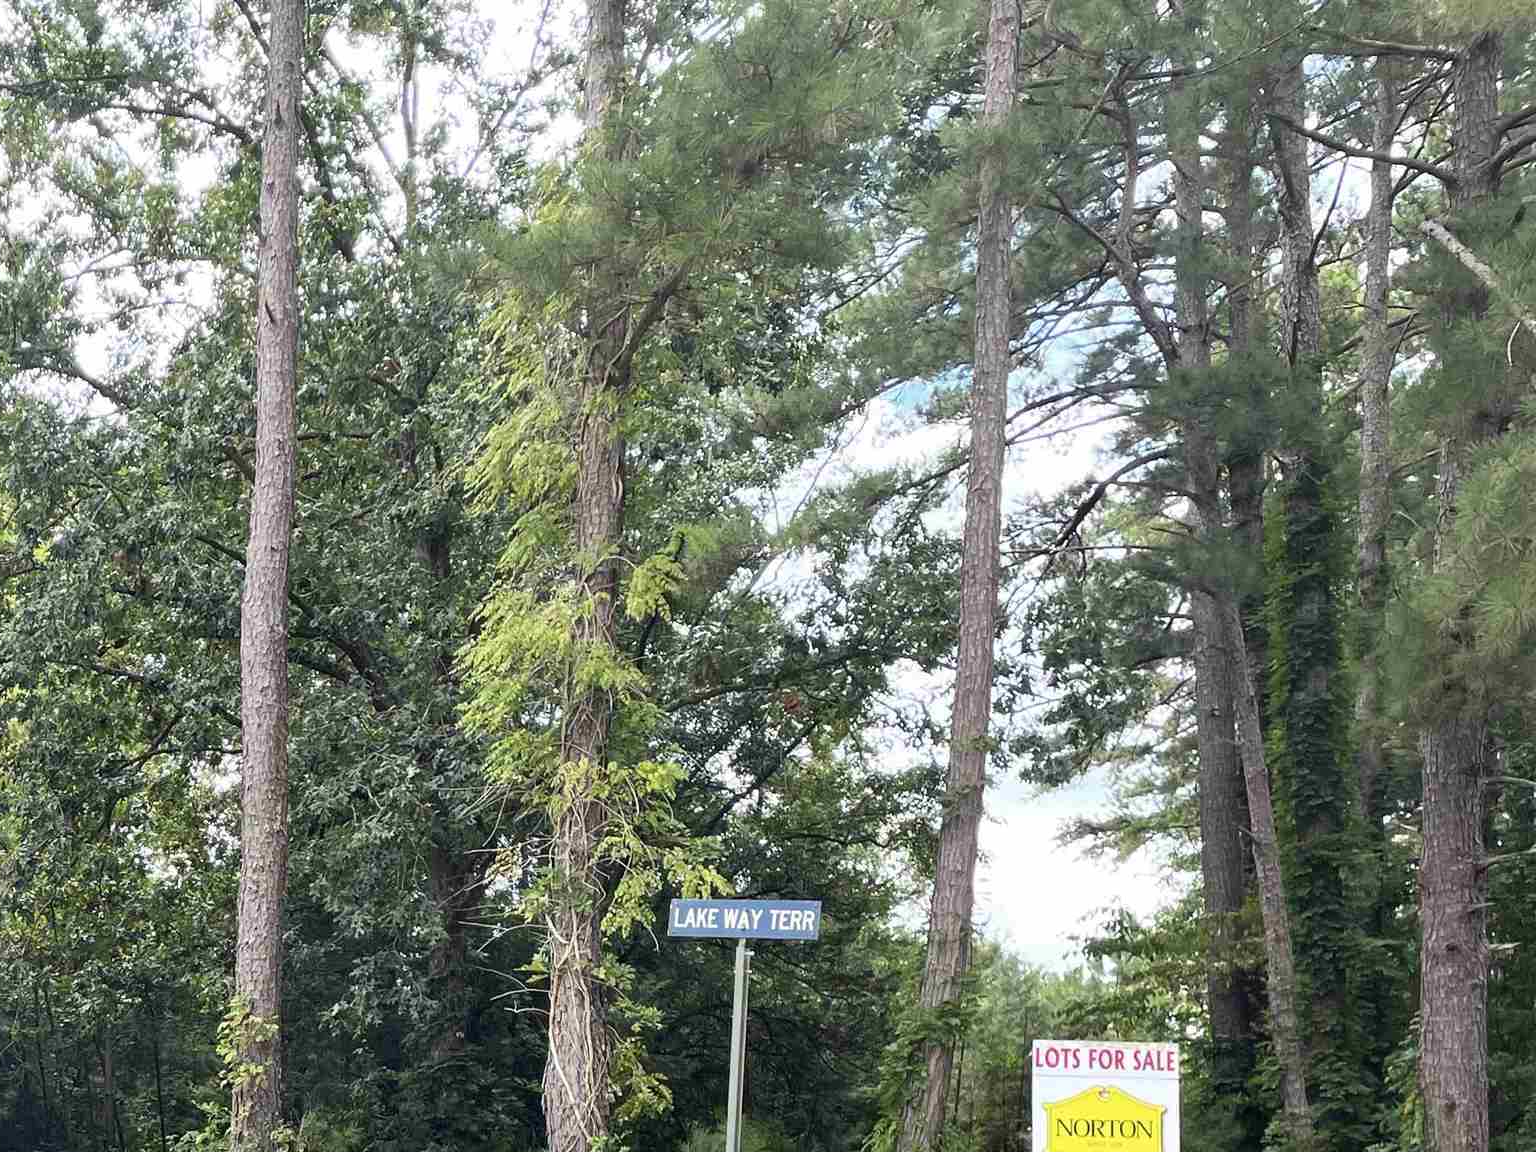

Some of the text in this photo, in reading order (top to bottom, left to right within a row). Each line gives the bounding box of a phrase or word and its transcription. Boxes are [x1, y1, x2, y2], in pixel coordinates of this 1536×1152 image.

[673, 908, 816, 931] LAKE WAY TERR
[1035, 1047, 1175, 1072] LOTS FOR SALE
[1055, 1118, 1153, 1139] NORTON
